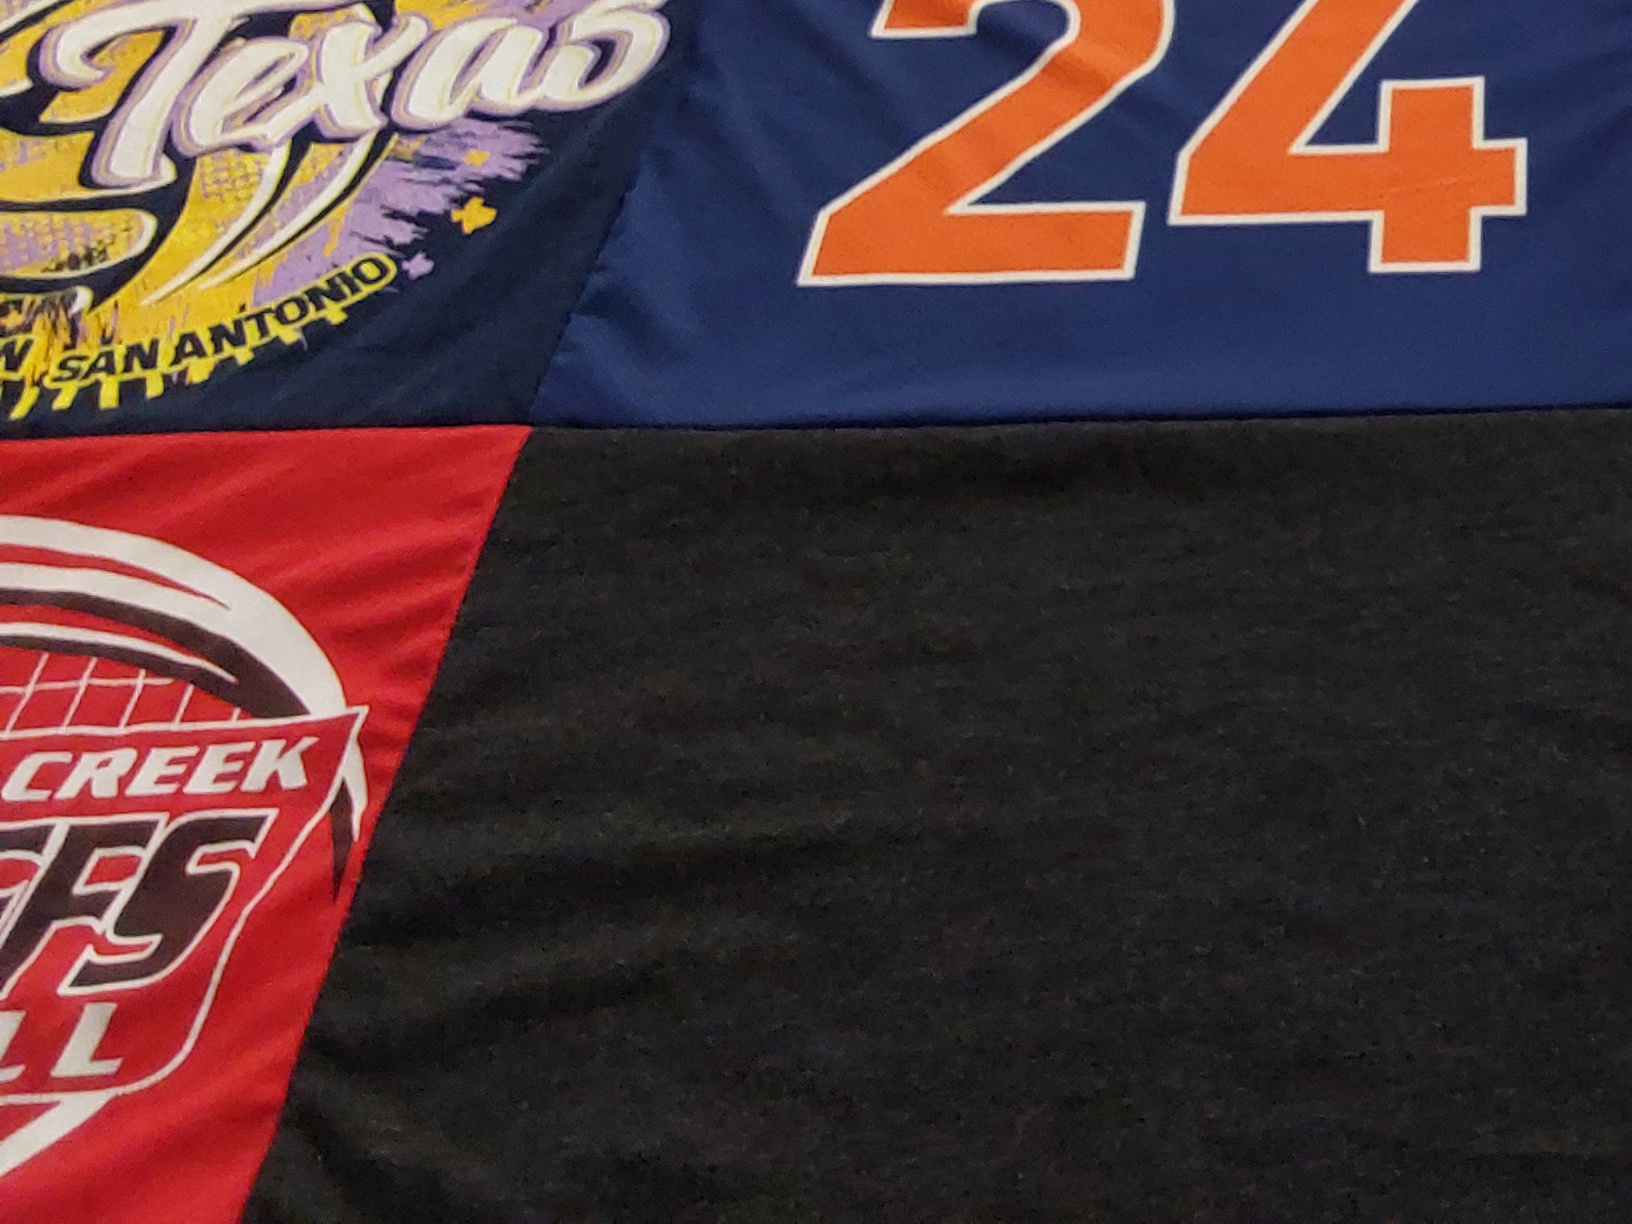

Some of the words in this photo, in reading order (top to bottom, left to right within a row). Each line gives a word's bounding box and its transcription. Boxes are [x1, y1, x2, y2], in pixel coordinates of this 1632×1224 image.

[50, 337, 160, 383] SAN
[173, 254, 392, 364] ANTONIO
[2, 736, 319, 802] CREEK
